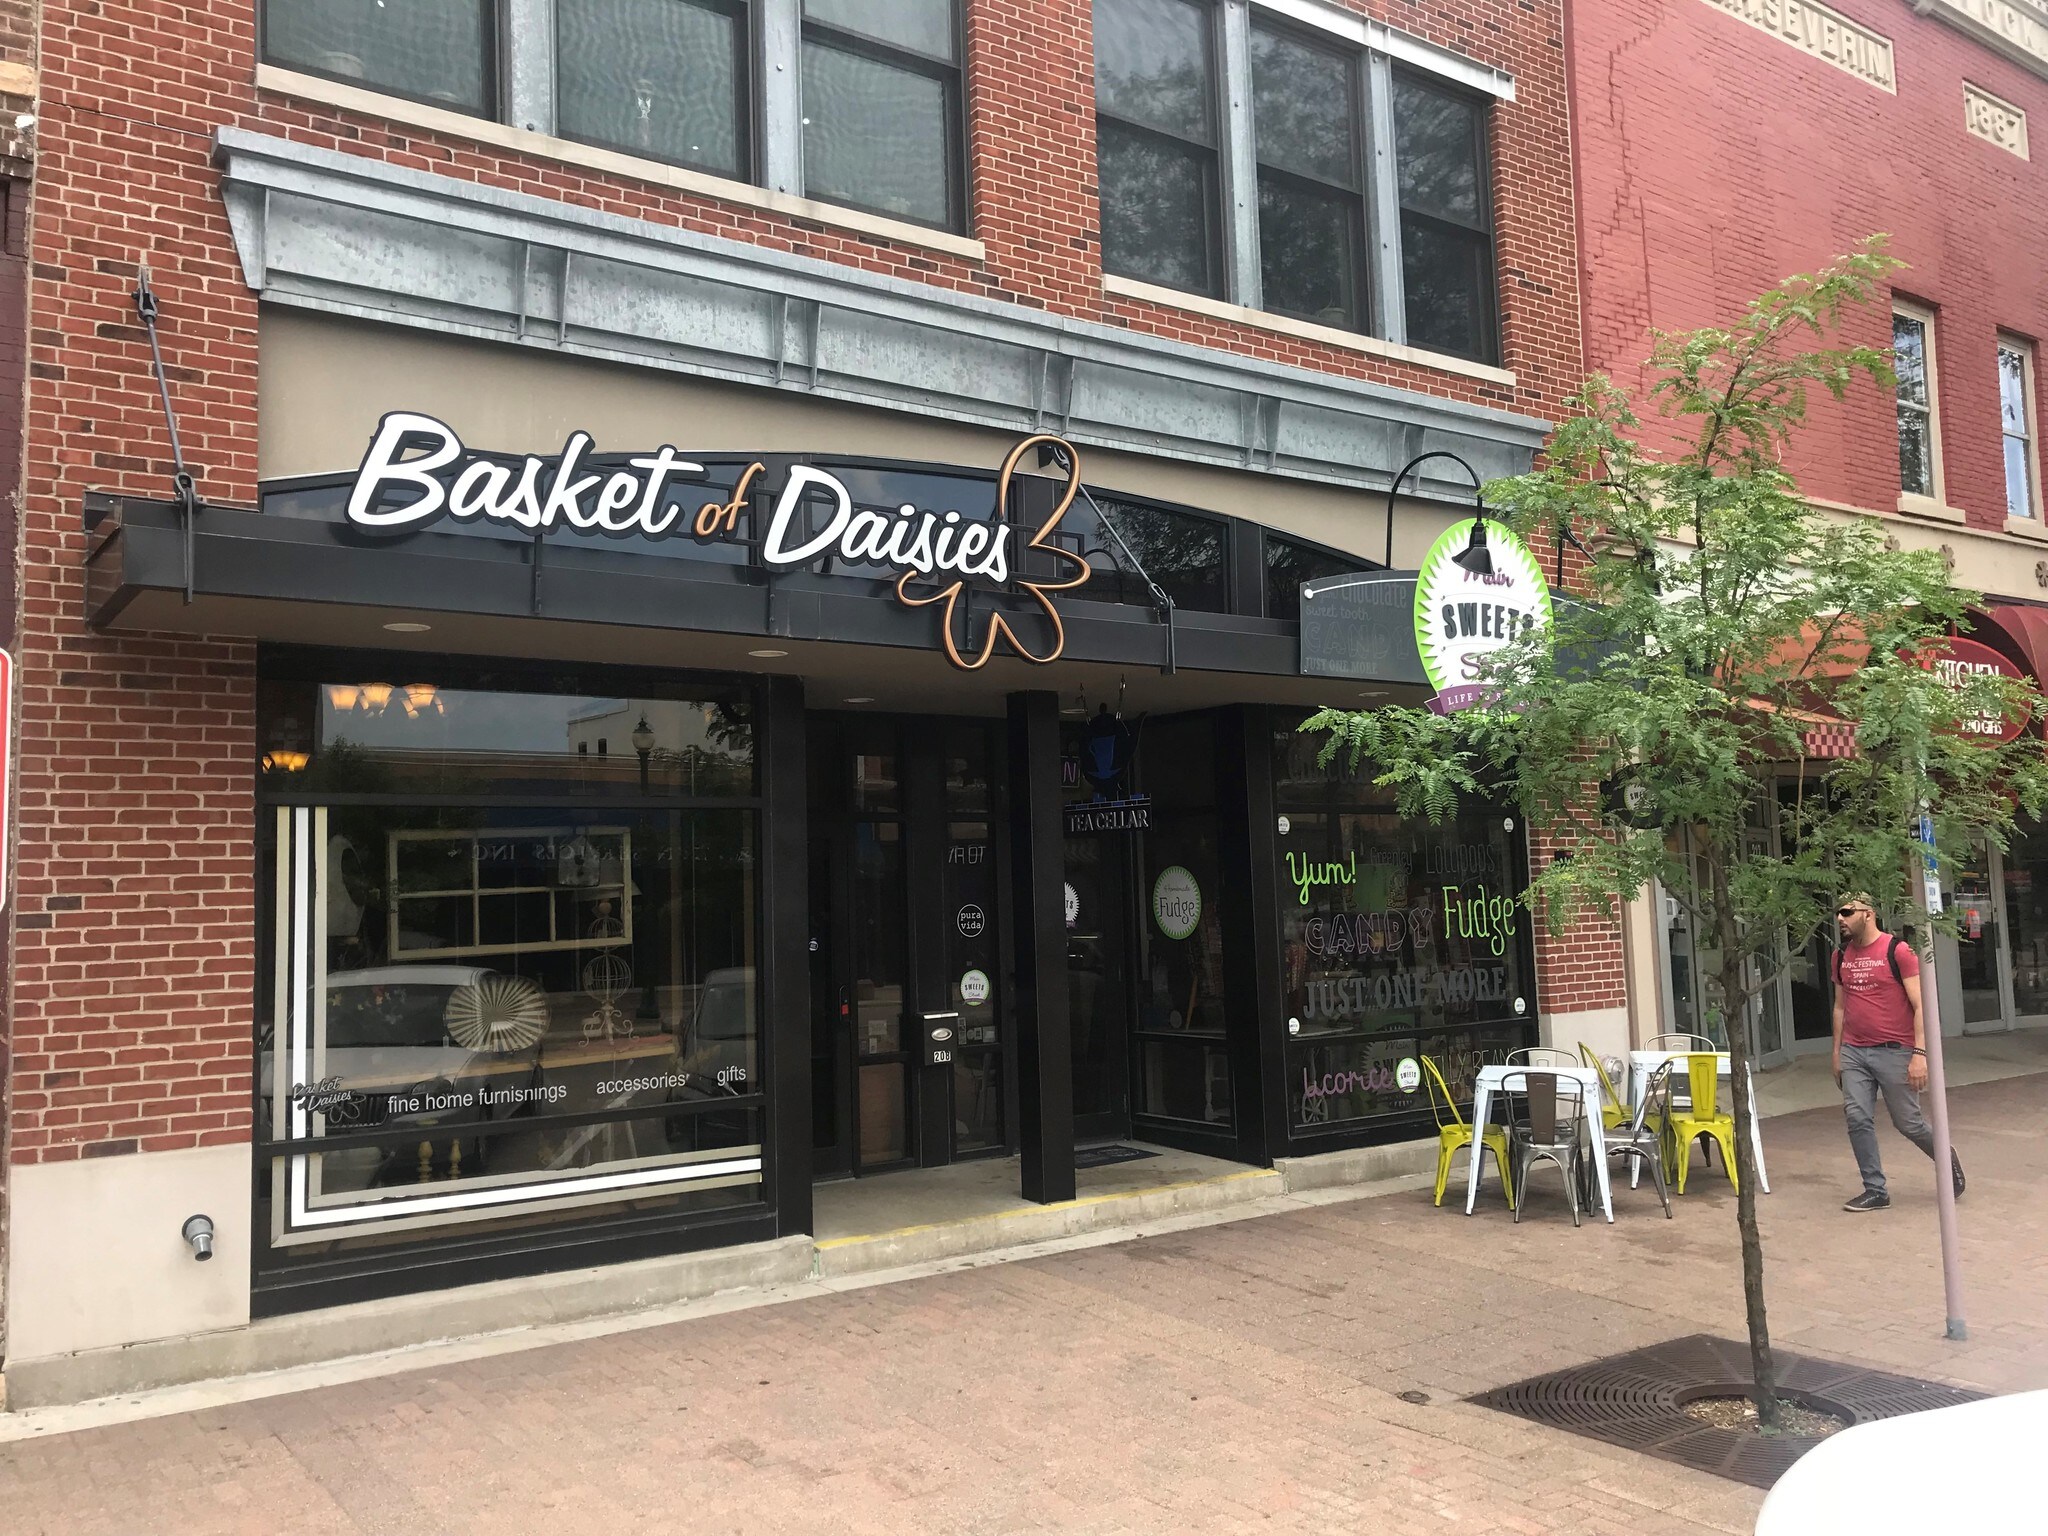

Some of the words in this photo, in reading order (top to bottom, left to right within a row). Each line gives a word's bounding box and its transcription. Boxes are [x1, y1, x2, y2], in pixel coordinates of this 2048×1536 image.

[1966, 93, 2020, 148] 1887
[346, 410, 705, 534] Basket
[694, 460, 767, 542] of
[761, 463, 1011, 582] Daisies
[1304, 621, 1413, 660] CANDY
[1305, 657, 1327, 672] JUST
[1328, 659, 1349, 673] ONE
[1351, 660, 1377, 674] MORE
[1447, 692, 1473, 706] LIFE
[1069, 813, 1093, 832] TEA
[1096, 809, 1149, 830] CELLAR
[1286, 850, 1357, 904] Yum!
[960, 911, 982, 923] pura
[1159, 896, 1195, 925] Fudge
[1442, 884, 1516, 956] Fudge
[960, 921, 982, 930] vida
[1305, 907, 1433, 955] CANDY
[1858, 959, 1885, 968] FESTIVAL
[964, 983, 985, 991] SWEETS
[1303, 977, 1368, 1019] JUST
[1374, 974, 1425, 1009] ONE
[1433, 966, 1507, 1001] MORE
[934, 1051, 951, 1062] 208
[1400, 1071, 1417, 1080] SWEETS
[388, 1095, 420, 1114] fine
[425, 1091, 473, 1111] home
[716, 1065, 747, 1086] gifts
